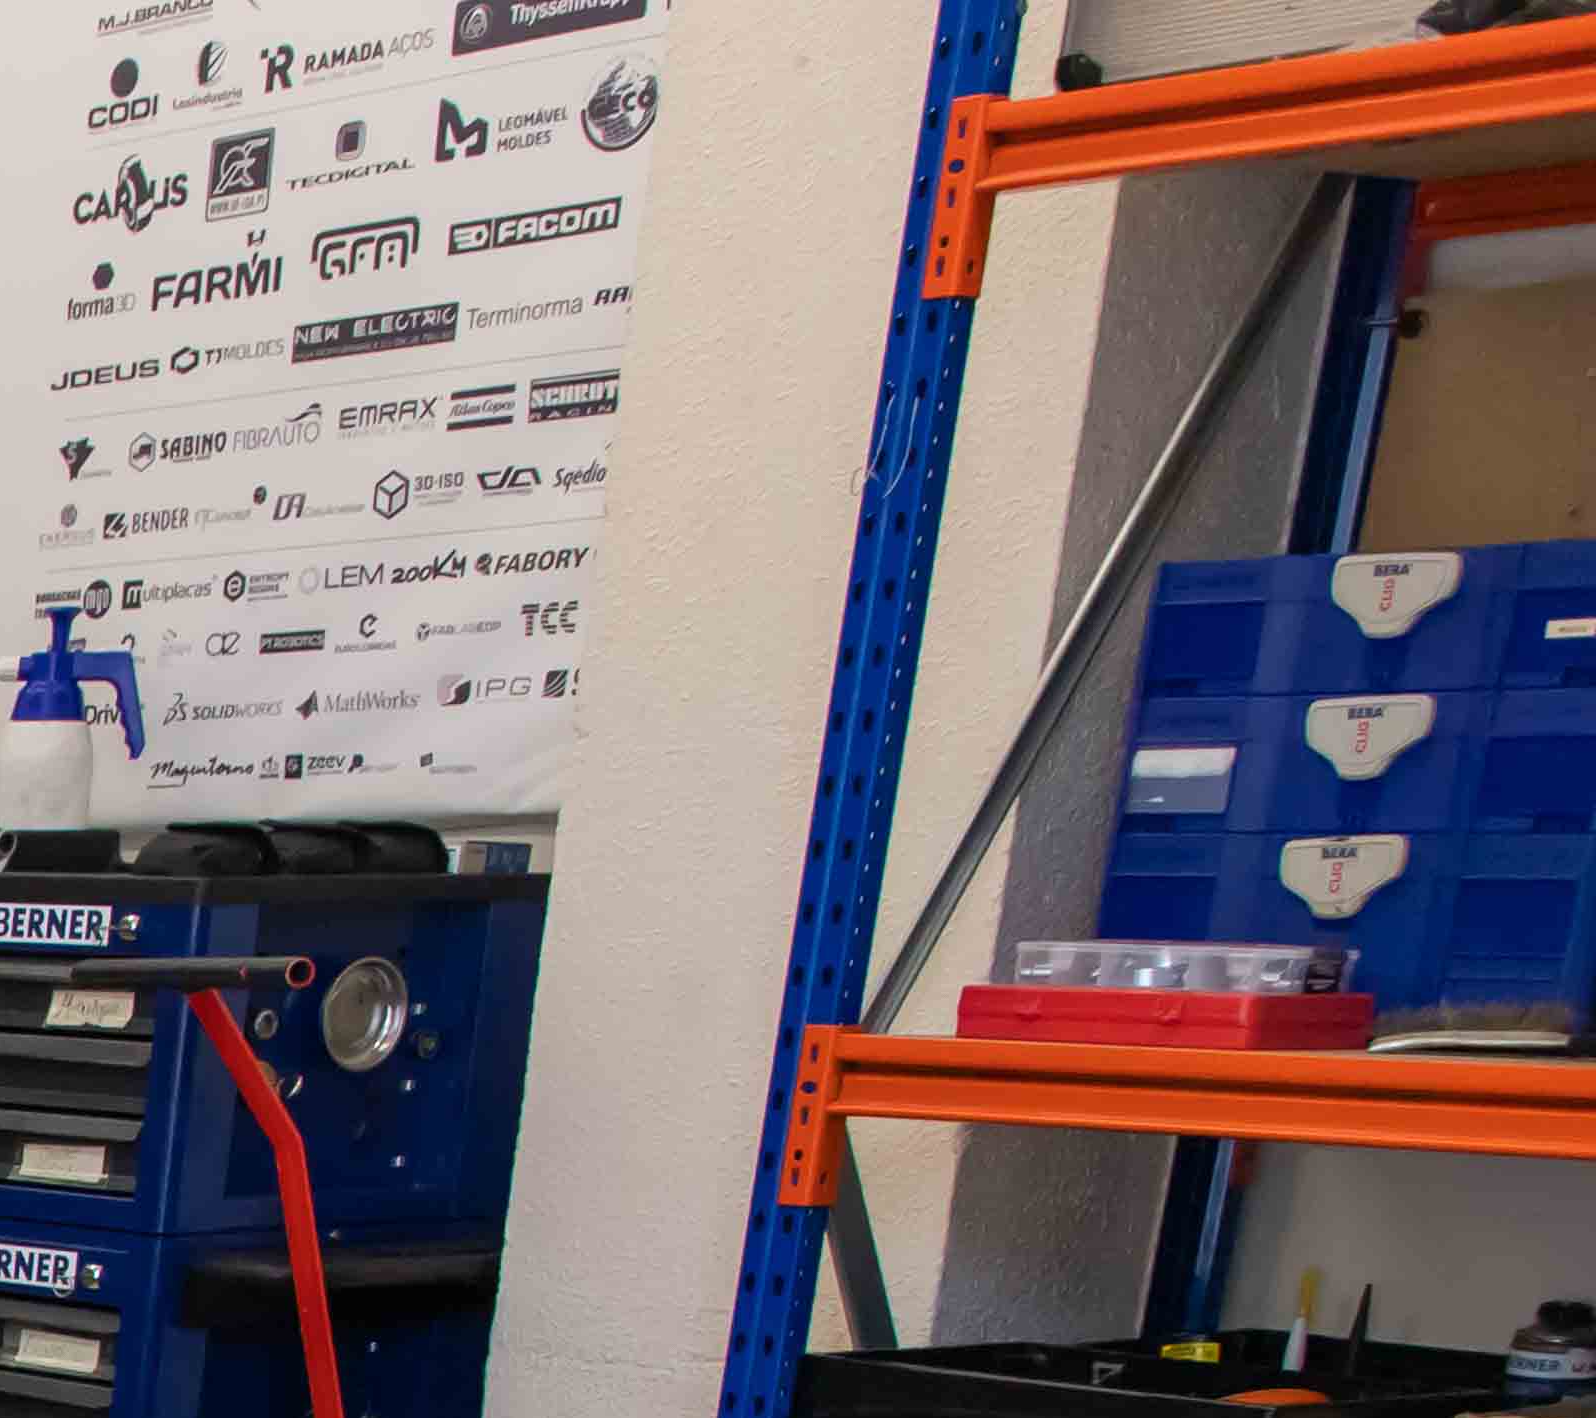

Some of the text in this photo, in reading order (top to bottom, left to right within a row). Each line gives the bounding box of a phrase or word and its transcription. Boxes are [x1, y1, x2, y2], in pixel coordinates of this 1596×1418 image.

[303, 41, 385, 75] RAMADA
[87, 94, 161, 130] CODI
[497, 202, 616, 243] FACOM
[150, 254, 284, 312] FARMI
[465, 296, 584, 331] Terminorma
[50, 359, 160, 392] JDEUS
[338, 395, 438, 431] EMRAX
[131, 506, 189, 535] BENDER
[323, 563, 385, 591] LEM
[493, 546, 590, 576] FABORY
[322, 687, 419, 715] MathWorks
[475, 676, 533, 699] IPG
[191, 699, 284, 722] SOLIDWORKS
